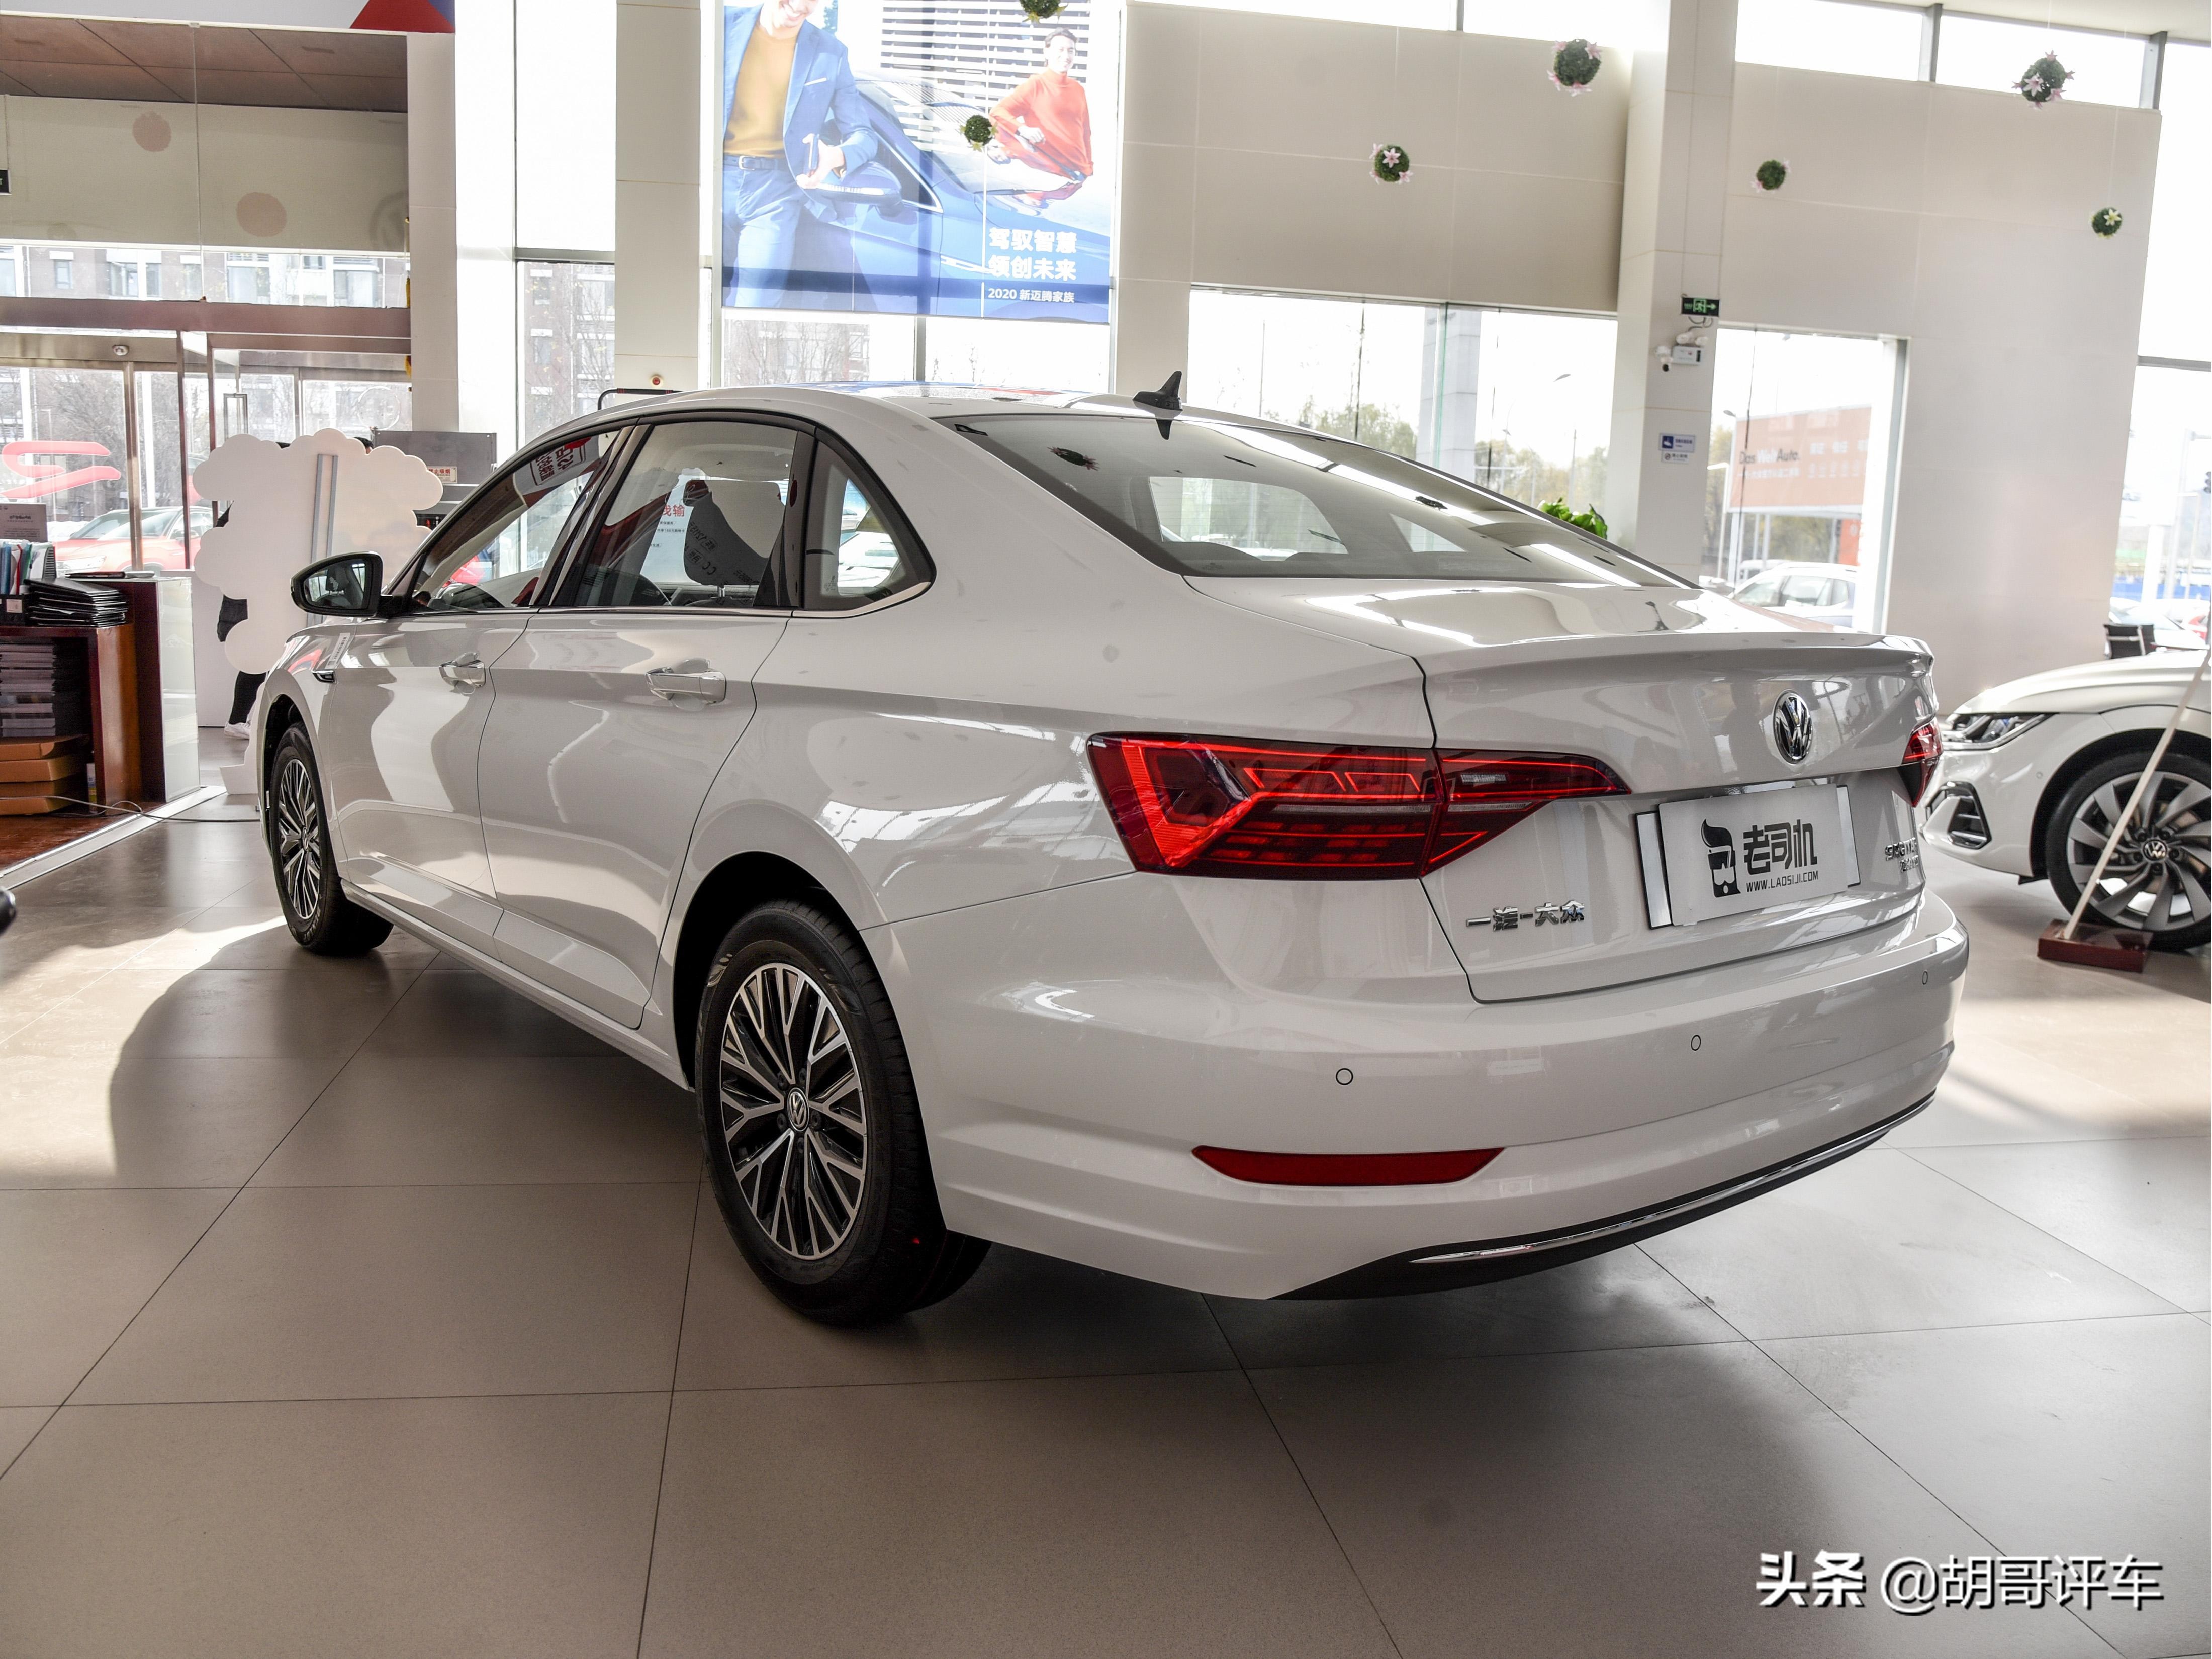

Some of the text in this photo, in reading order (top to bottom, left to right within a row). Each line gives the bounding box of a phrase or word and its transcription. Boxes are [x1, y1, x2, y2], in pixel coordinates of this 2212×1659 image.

[988, 227, 1077, 254] 驾驭智慧
[988, 255, 1077, 282] 领创未来
[988, 288, 1075, 303] 2020 新迈腾家族
[1743, 819, 1818, 875] 老司机
[1746, 870, 1819, 893] WWW.LAOSIJI.COM
